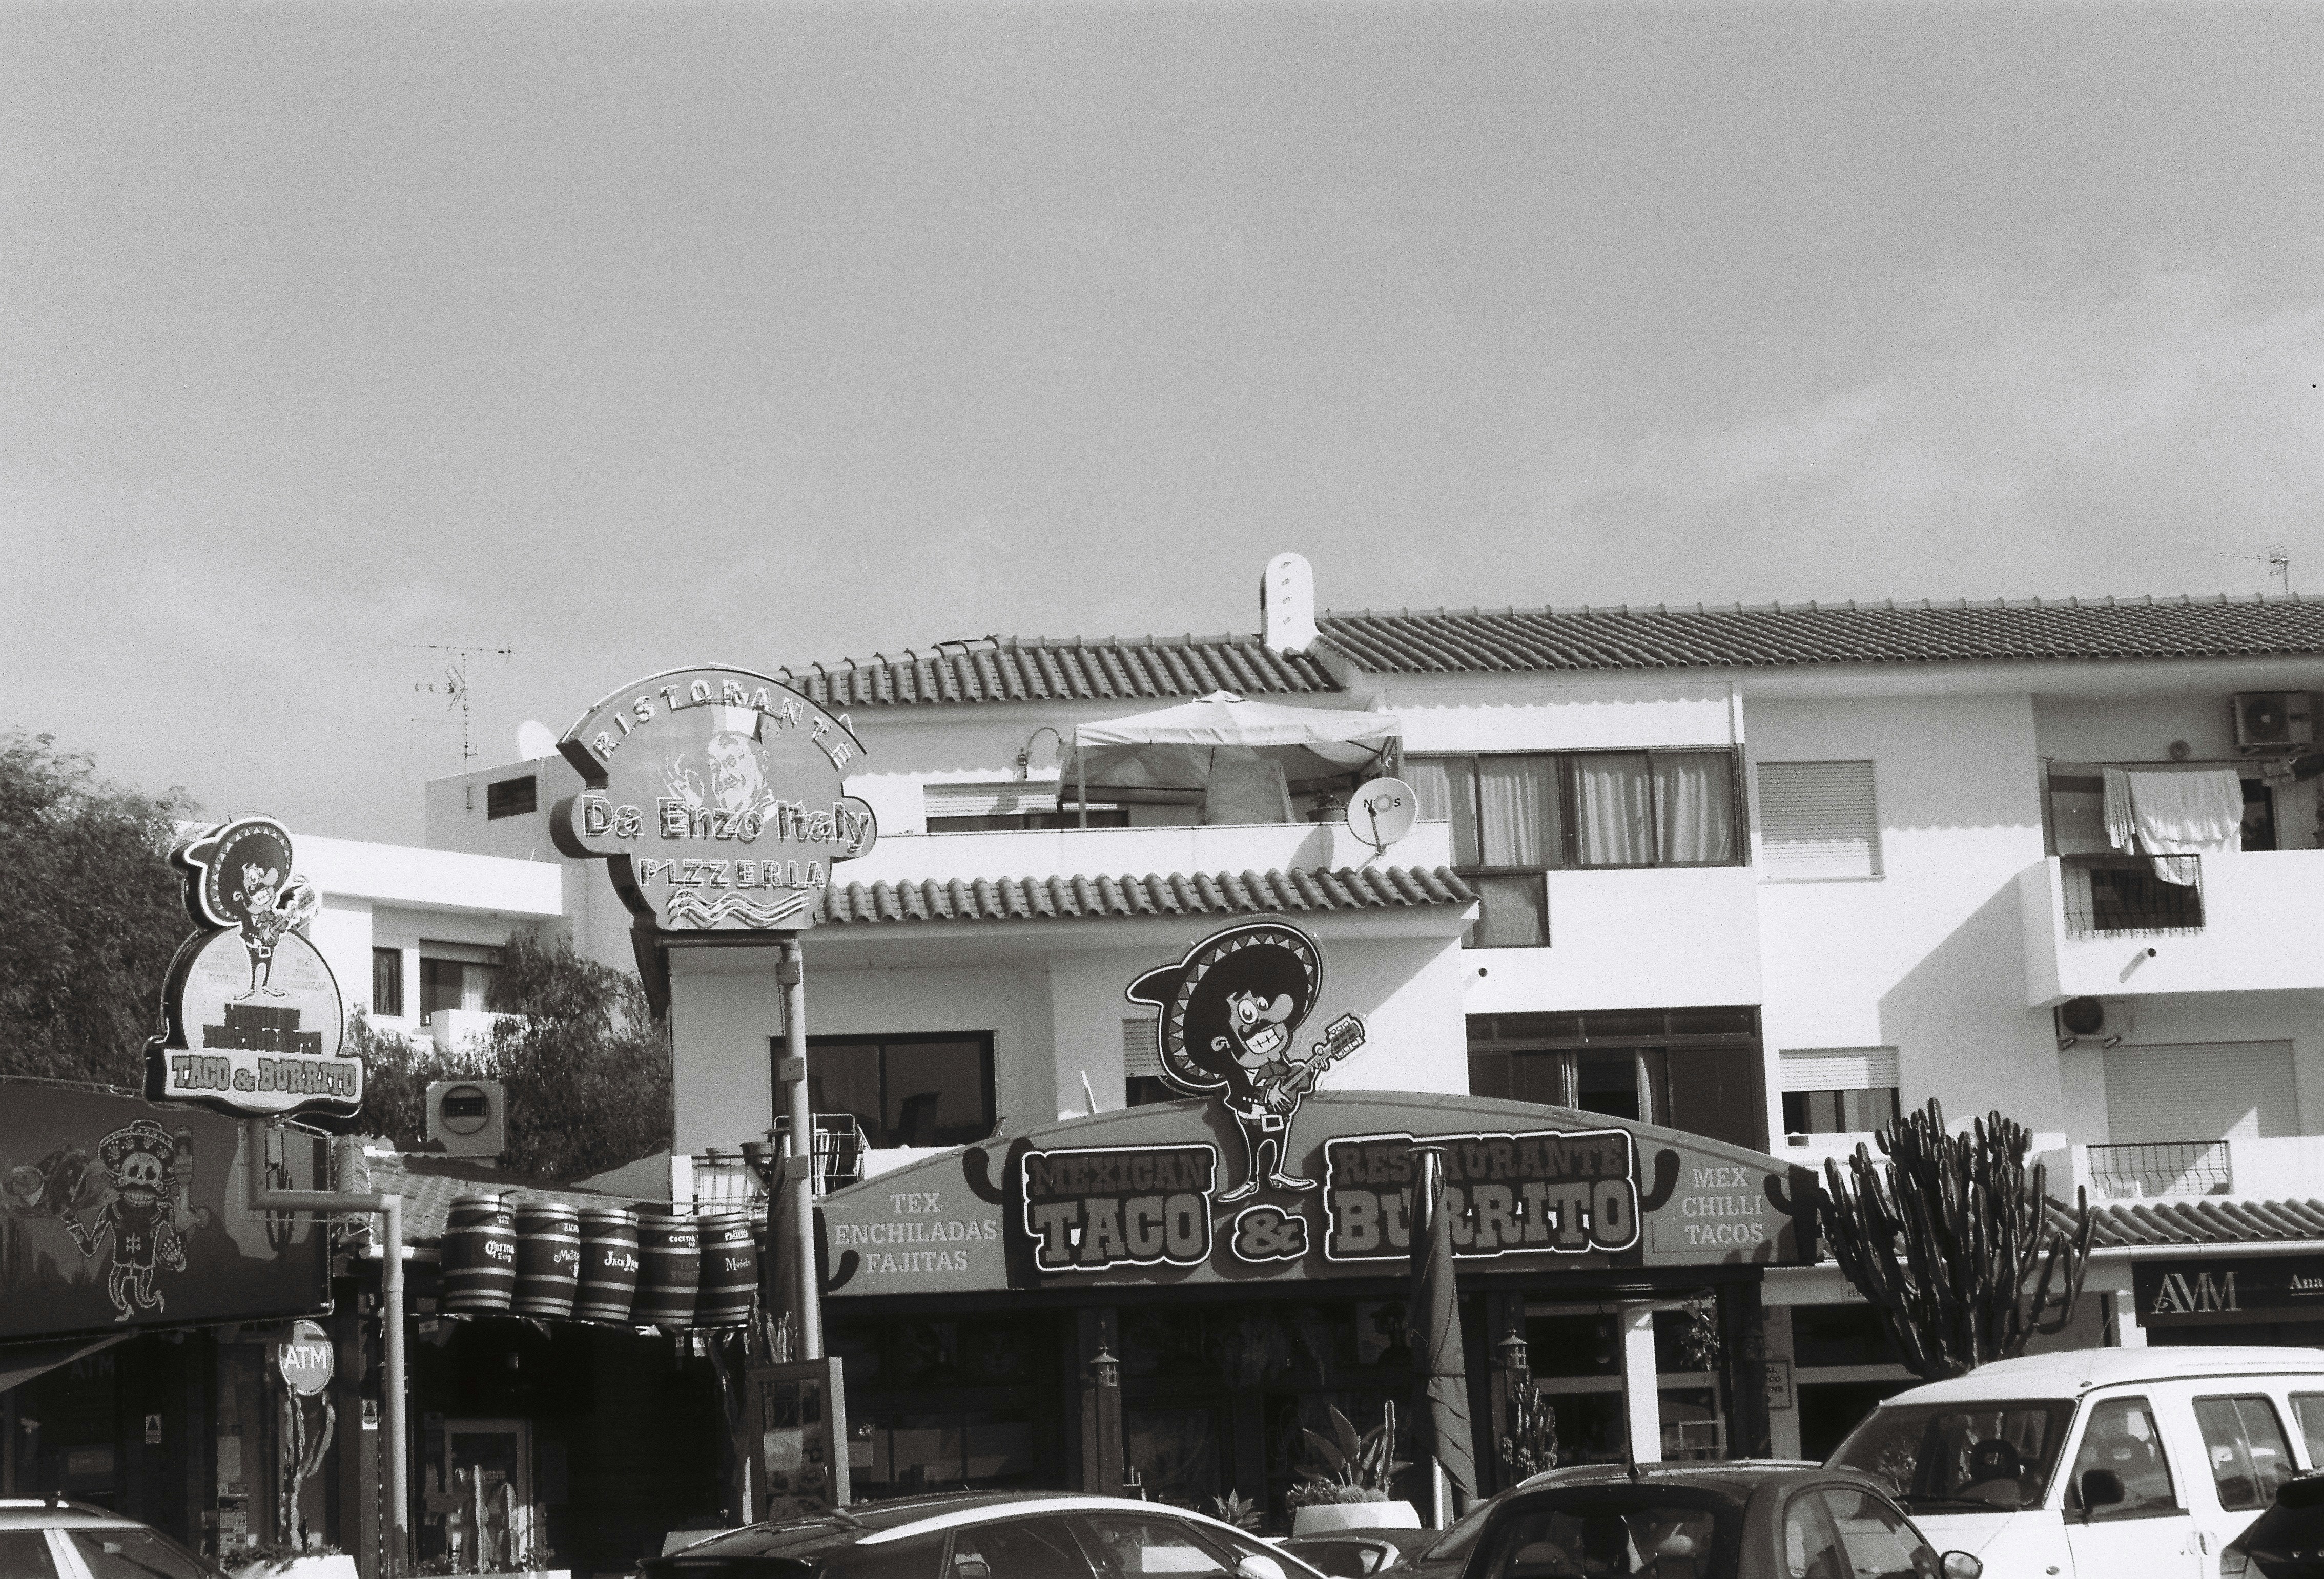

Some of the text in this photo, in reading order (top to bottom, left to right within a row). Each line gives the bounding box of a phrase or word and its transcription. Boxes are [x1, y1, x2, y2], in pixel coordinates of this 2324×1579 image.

[592, 679, 856, 772] RISTORANTE
[582, 795, 872, 851] Da Enzo Italy
[639, 859, 827, 887] PIZZERIA
[172, 1056, 357, 1096] TACO & BURRITO
[1032, 1154, 1205, 1196] MEXICAN
[1336, 1138, 1623, 1185] RESAURANTE
[1693, 1167, 1749, 1188] MEX
[890, 1192, 941, 1214] TEX
[1683, 1195, 1763, 1217] CHILLI
[835, 1219, 997, 1244] ENCHILADAS
[1034, 1194, 1203, 1261] TACO
[1242, 1212, 1301, 1254] &
[1684, 1223, 1764, 1245] TACOS
[867, 1250, 968, 1273] FAJITAS
[2151, 1272, 2243, 1314] AVM
[284, 1346, 327, 1369] ATM
